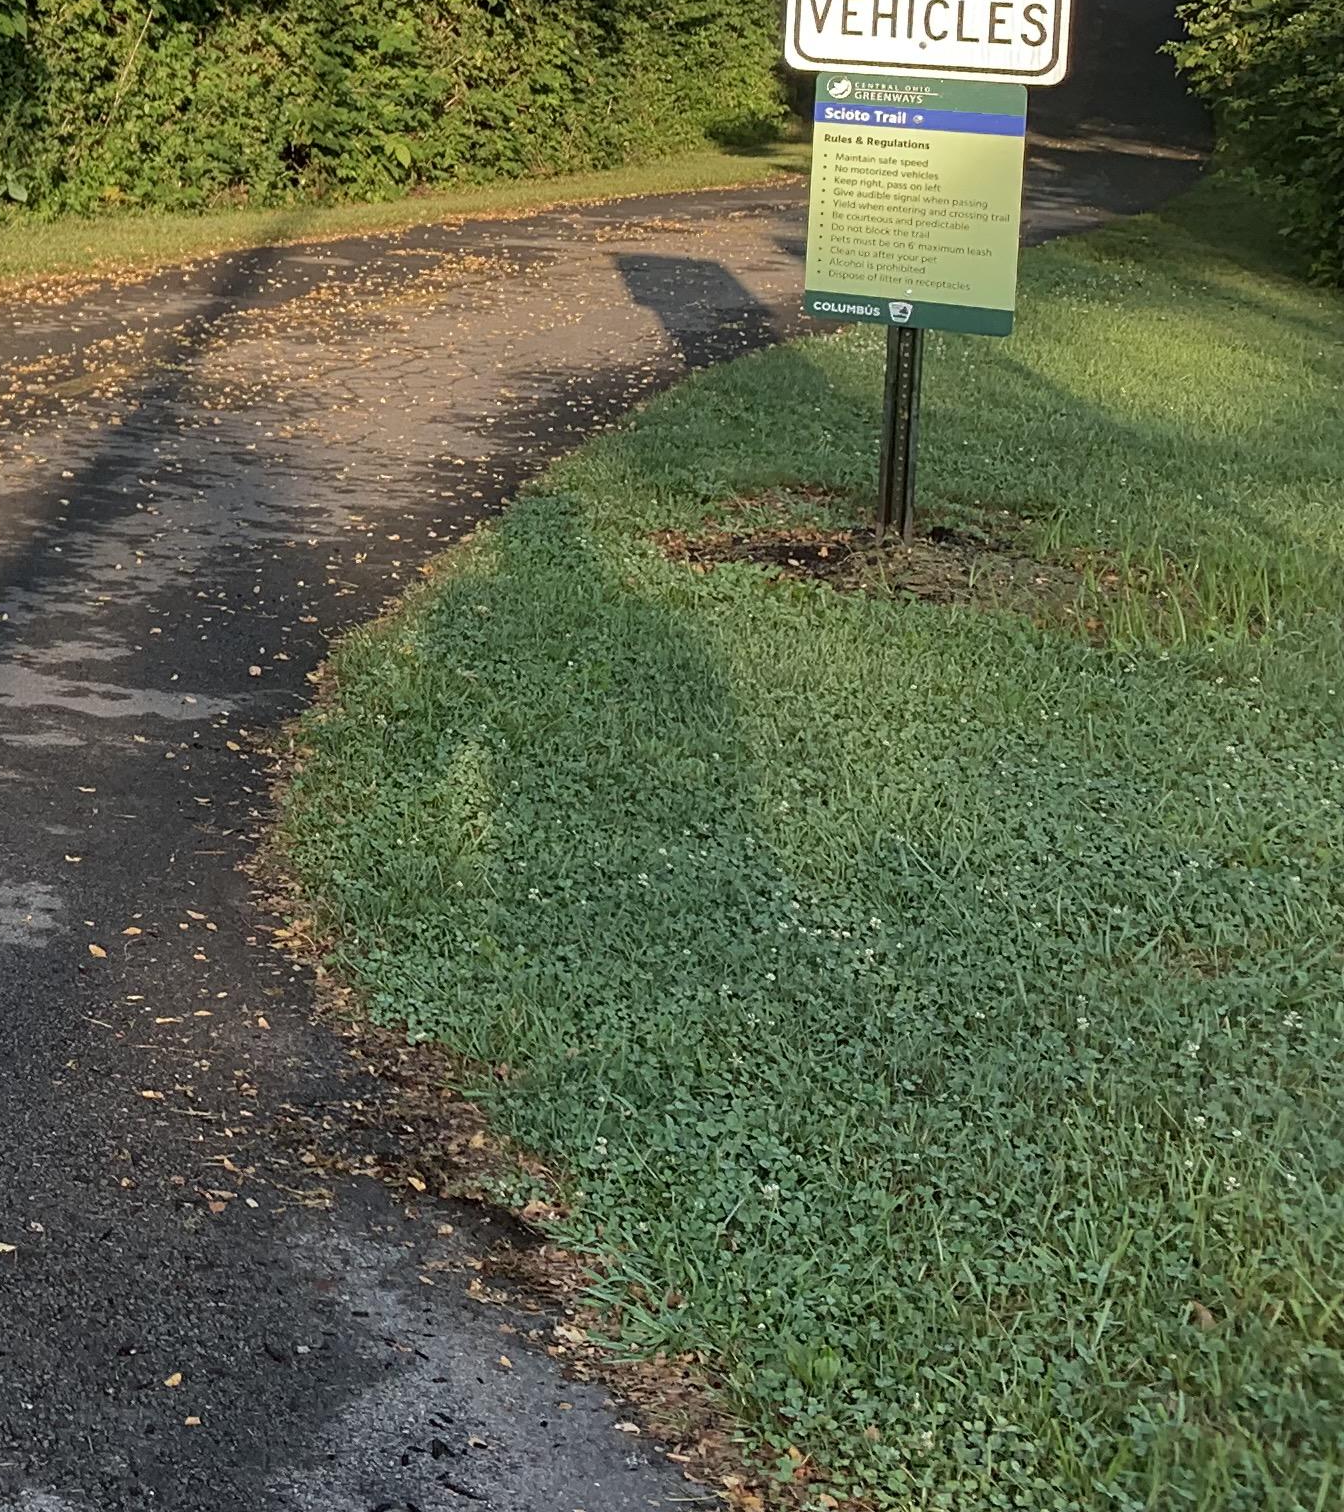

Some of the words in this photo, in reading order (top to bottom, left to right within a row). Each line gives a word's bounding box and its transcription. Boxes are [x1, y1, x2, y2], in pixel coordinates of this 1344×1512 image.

[854, 82, 900, 92] CENTRAL
[904, 85, 932, 93] OHIO
[854, 91, 924, 104] GREENWAYS
[824, 107, 870, 122] Scioto
[874, 110, 907, 124] Trail
[824, 133, 852, 144] Rules
[855, 135, 864, 145] &
[866, 137, 930, 149] Regulations
[835, 153, 876, 163] Maintain
[878, 157, 897, 165] safe
[900, 159, 929, 168] speed
[834, 164, 848, 173] No
[851, 167, 899, 177] motorized
[901, 171, 939, 180] vehicles
[834, 176, 857, 186] Keep
[887, 181, 907, 190] pass
[909, 183, 922, 191] on
[924, 183, 941, 192] left
[833, 187, 854, 197] Give
[856, 190, 890, 200] audible
[893, 193, 921, 203] signal
[923, 196, 950, 204] when
[952, 199, 988, 210] passing
[833, 199, 856, 208] Yield
[858, 202, 884, 210] when
[886, 205, 926, 216] entering
[928, 208, 947, 217] and
[948, 211, 988, 222] crossing
[991, 213, 1010, 222] trail
[846, 213, 893, 224] courteous
[895, 217, 913, 226] and
[915, 219, 970, 231] predictable
[831, 223, 844, 231] Do
[847, 225, 863, 233] not
[865, 226, 890, 235] block
[893, 229, 909, 237] the
[912, 230, 930, 238] trail
[830, 234, 851, 243] Pets
[853, 238, 876, 246] must
[878, 239, 890, 247] be
[918, 244, 965, 255] maximum
[967, 247, 992, 257] leash
[830, 246, 856, 256] Clean
[858, 248, 870, 258] up
[872, 250, 894, 260] after
[896, 254, 918, 262] your
[921, 255, 937, 264] pet
[829, 257, 864, 268] Alcohol
[867, 261, 874, 269] is
[876, 262, 926, 274] prohibited
[828, 269, 866, 280] Dispose
[867, 273, 878, 281] of
[879, 274, 903, 285] litter
[904, 277, 913, 285] in
[915, 279, 972, 291] receptacles
[813, 301, 881, 316] COLUMBUS
